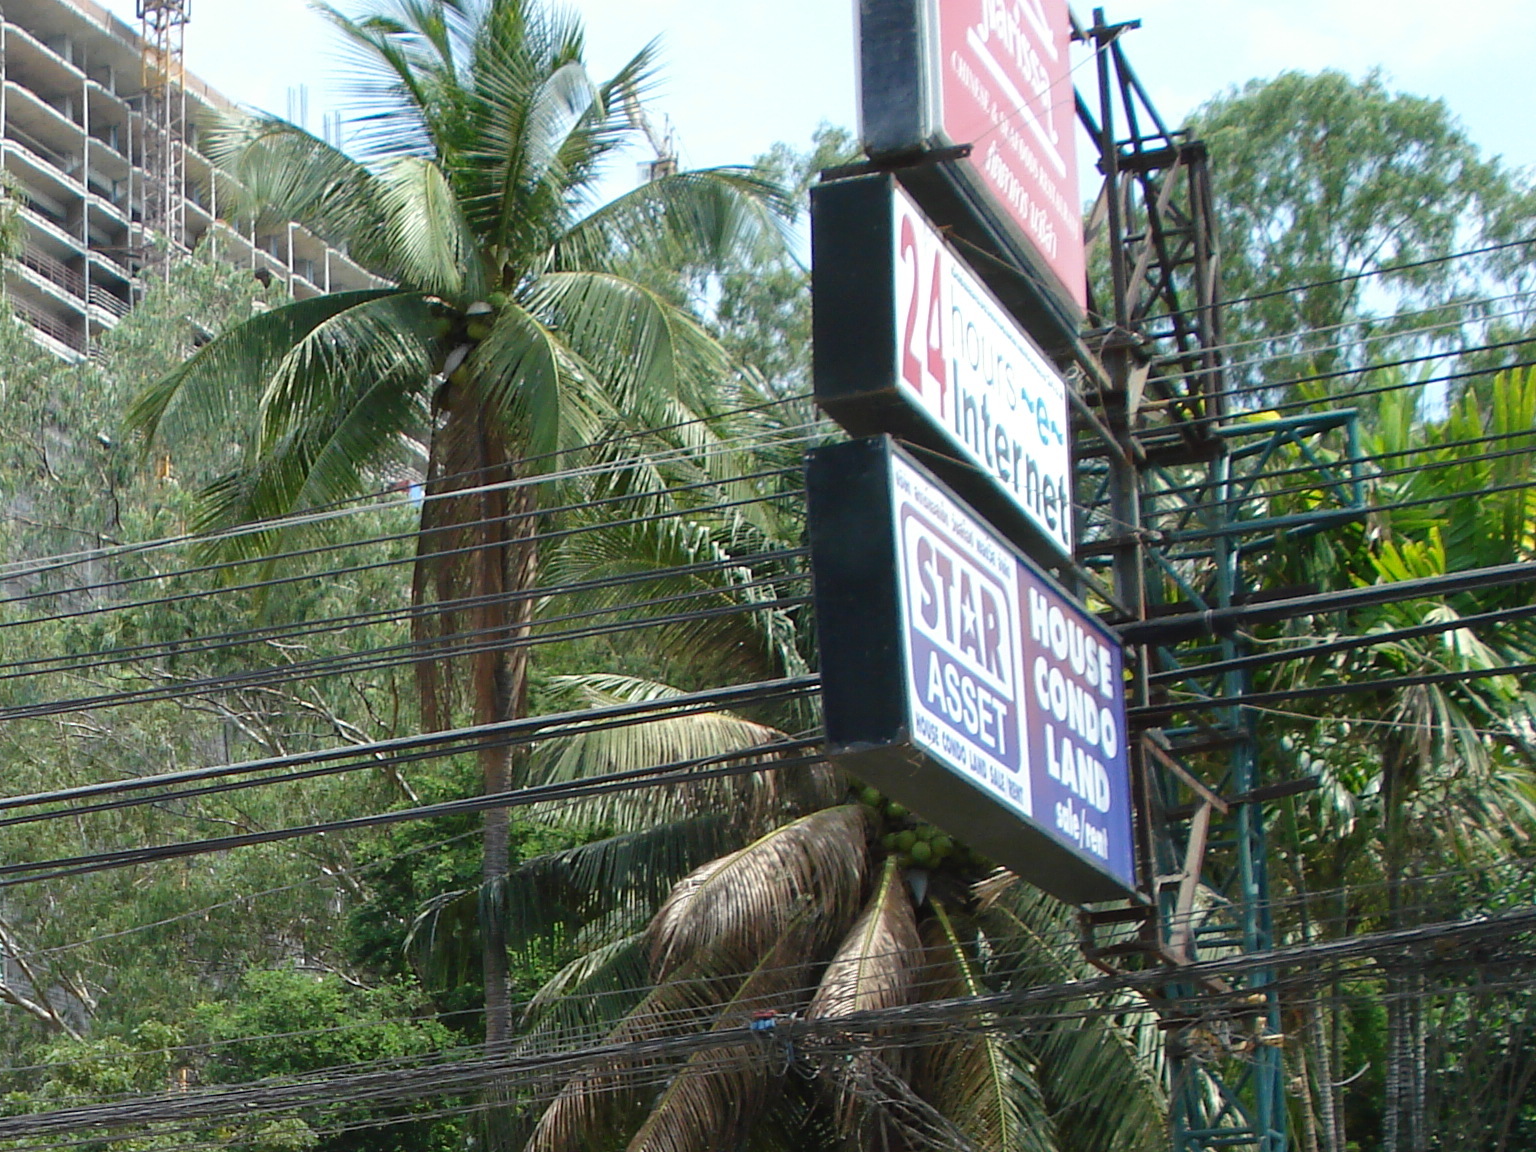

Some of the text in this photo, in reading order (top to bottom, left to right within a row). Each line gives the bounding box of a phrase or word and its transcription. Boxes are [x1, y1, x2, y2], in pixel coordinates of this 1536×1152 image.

[900, 213, 948, 420] 24
[950, 281, 1016, 412] hours
[952, 357, 1069, 547] Internet
[917, 535, 1011, 690] STAR
[1029, 586, 1114, 700] HOUSE
[927, 651, 1008, 756] ASSET
[1034, 656, 1118, 760] CONDO
[1045, 723, 1111, 814] LAND
